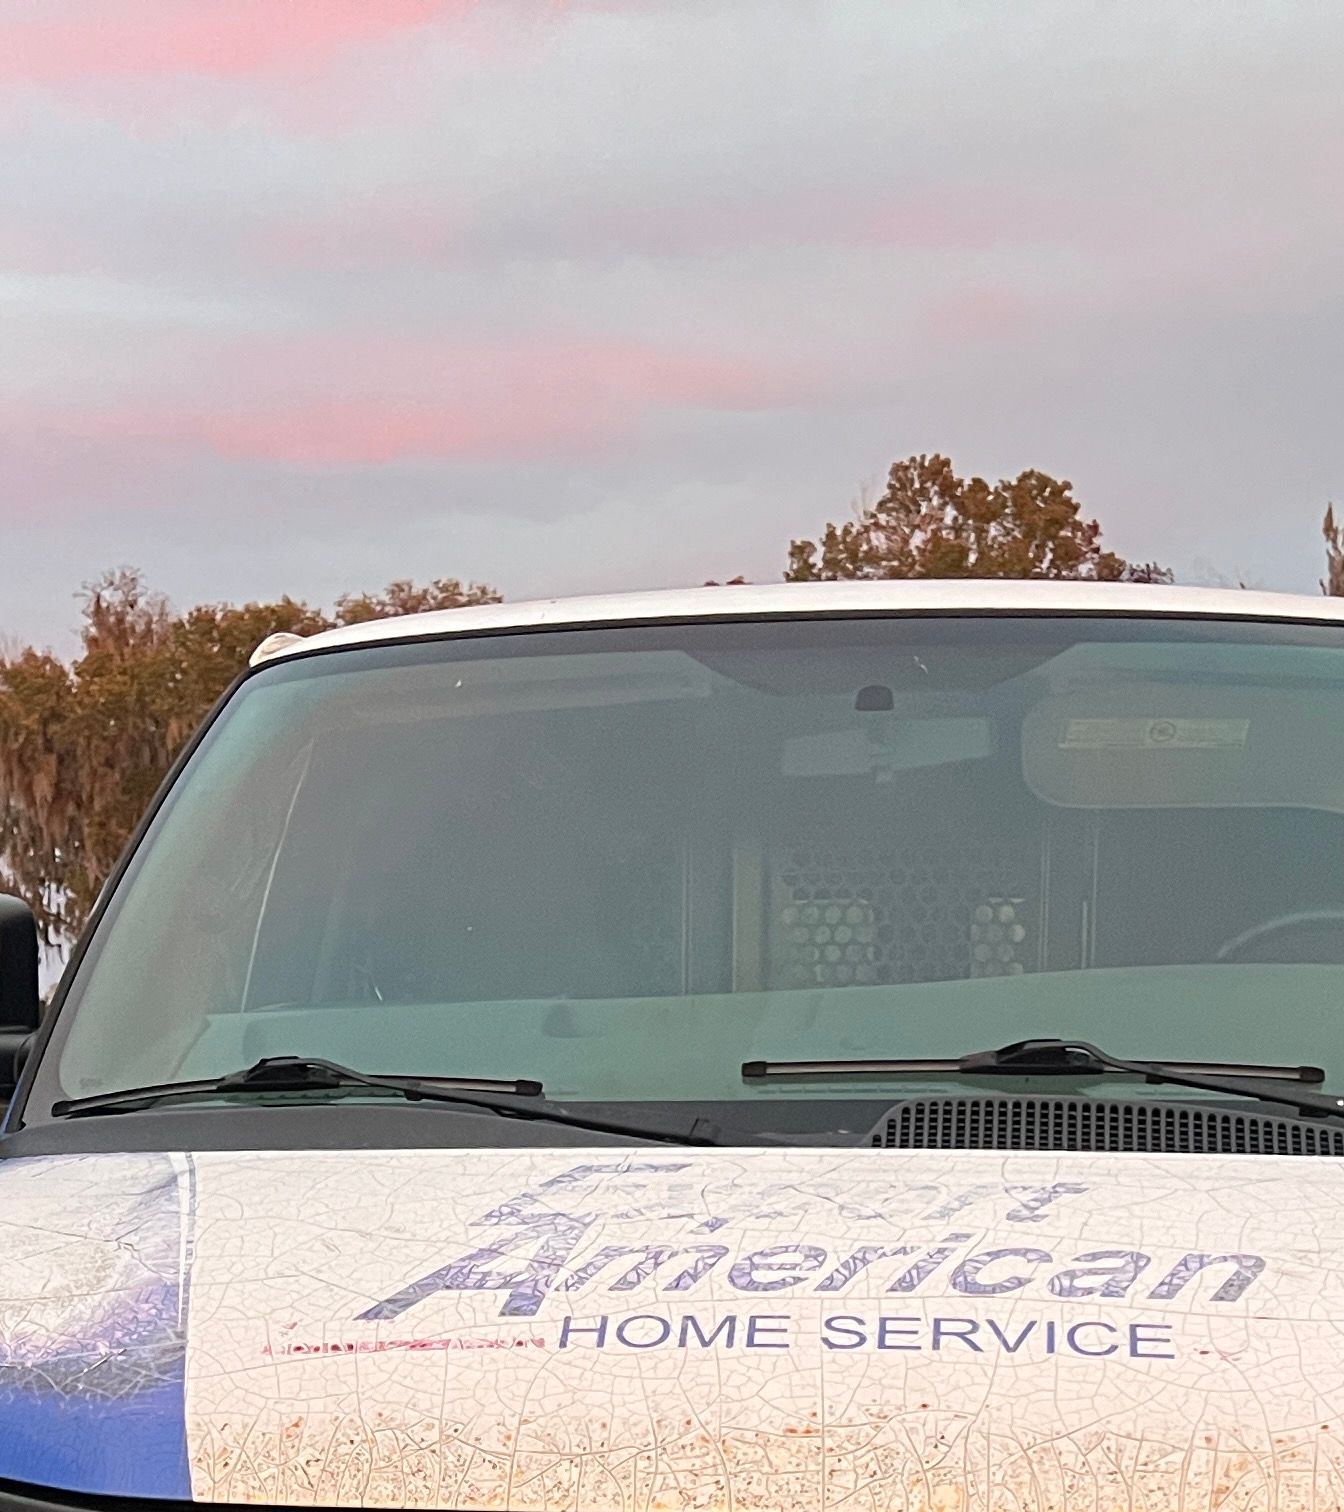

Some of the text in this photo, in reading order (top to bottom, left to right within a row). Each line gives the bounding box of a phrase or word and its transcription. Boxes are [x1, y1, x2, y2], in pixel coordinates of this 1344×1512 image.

[353, 1213, 1266, 1319] American
[559, 1315, 792, 1350] HOME
[820, 1316, 1176, 1359] SERVICE
